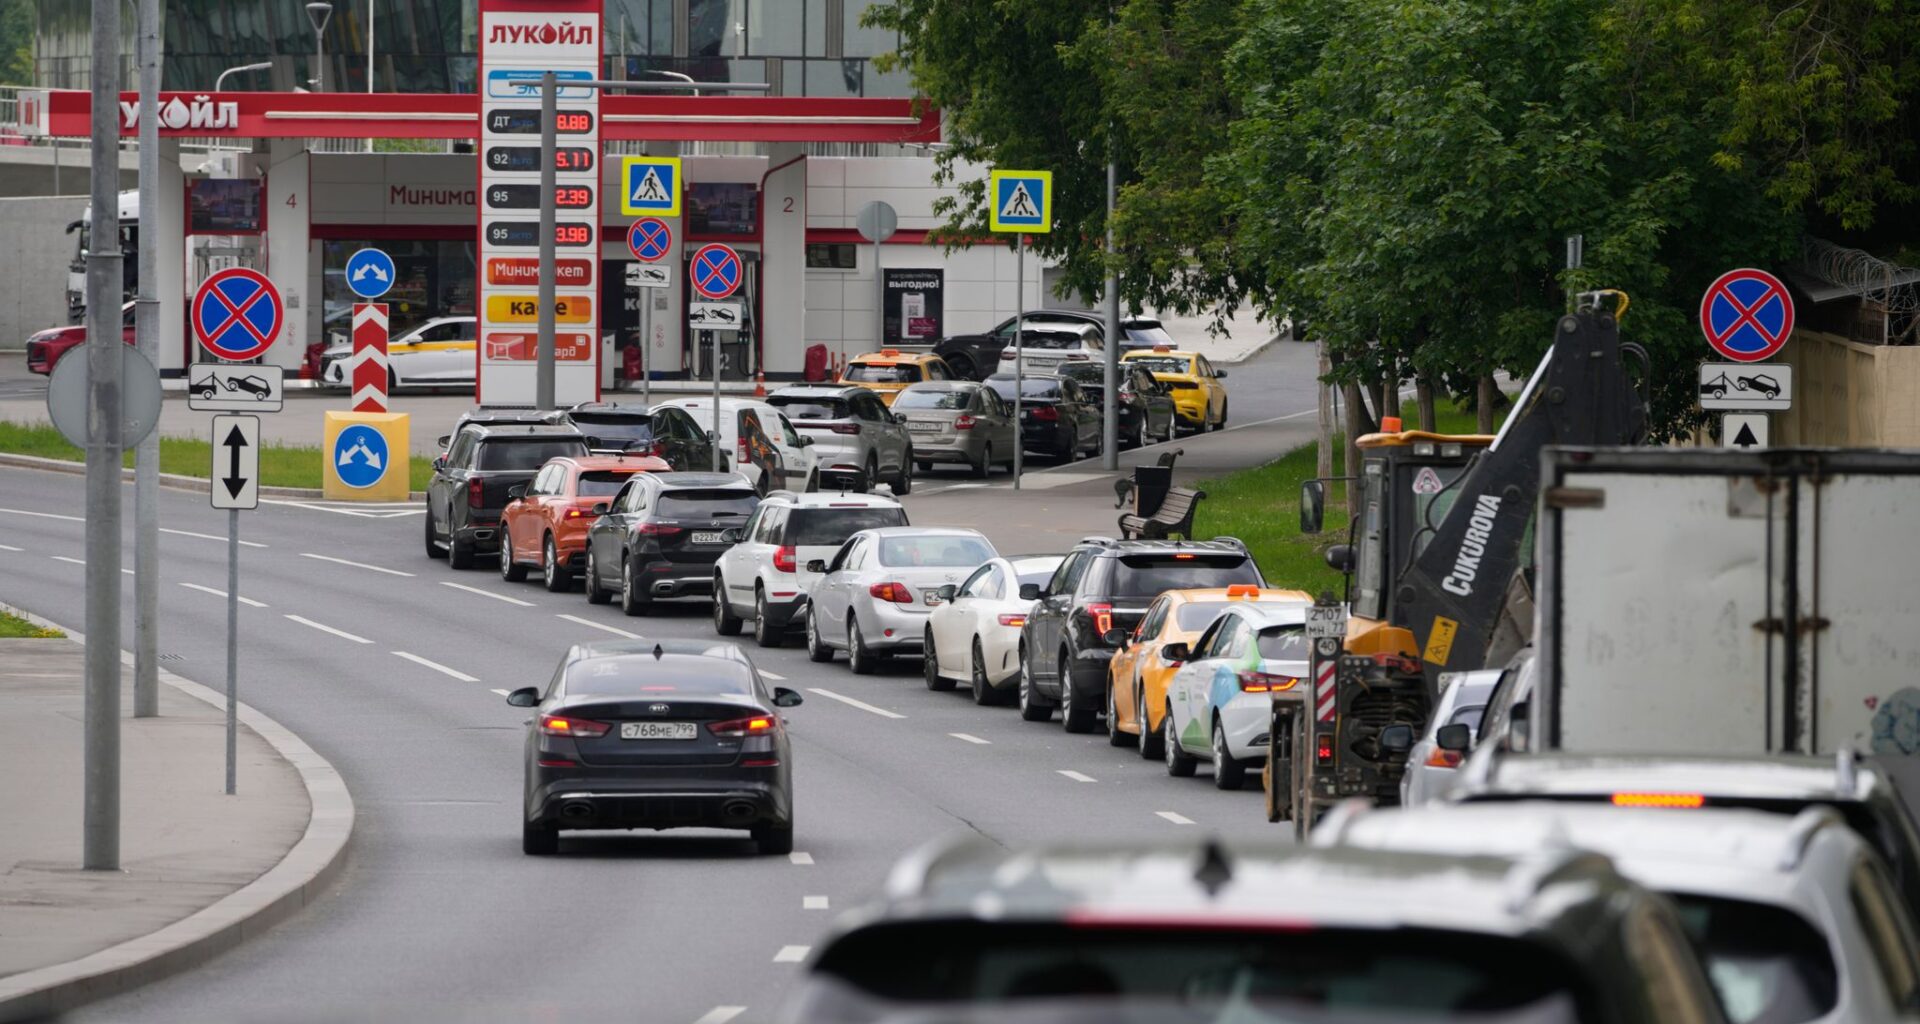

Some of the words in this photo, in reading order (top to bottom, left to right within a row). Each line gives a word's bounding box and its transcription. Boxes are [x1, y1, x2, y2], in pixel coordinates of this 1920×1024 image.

[490, 22, 592, 44] ЛУКОЙЛ
[119, 95, 239, 130] УКОЙЛ
[493, 116, 510, 128] ДТ
[493, 154, 508, 165] 92
[286, 193, 297, 209] 4
[493, 192, 508, 203] 95
[783, 197, 794, 213] 2
[493, 229, 508, 240] 95
[495, 263, 584, 277] Минимкет
[888, 280, 939, 290] выгодно!
[510, 302, 567, 316] кае
[1310, 608, 1342, 621] 2107
[1320, 640, 1335, 651] 40
